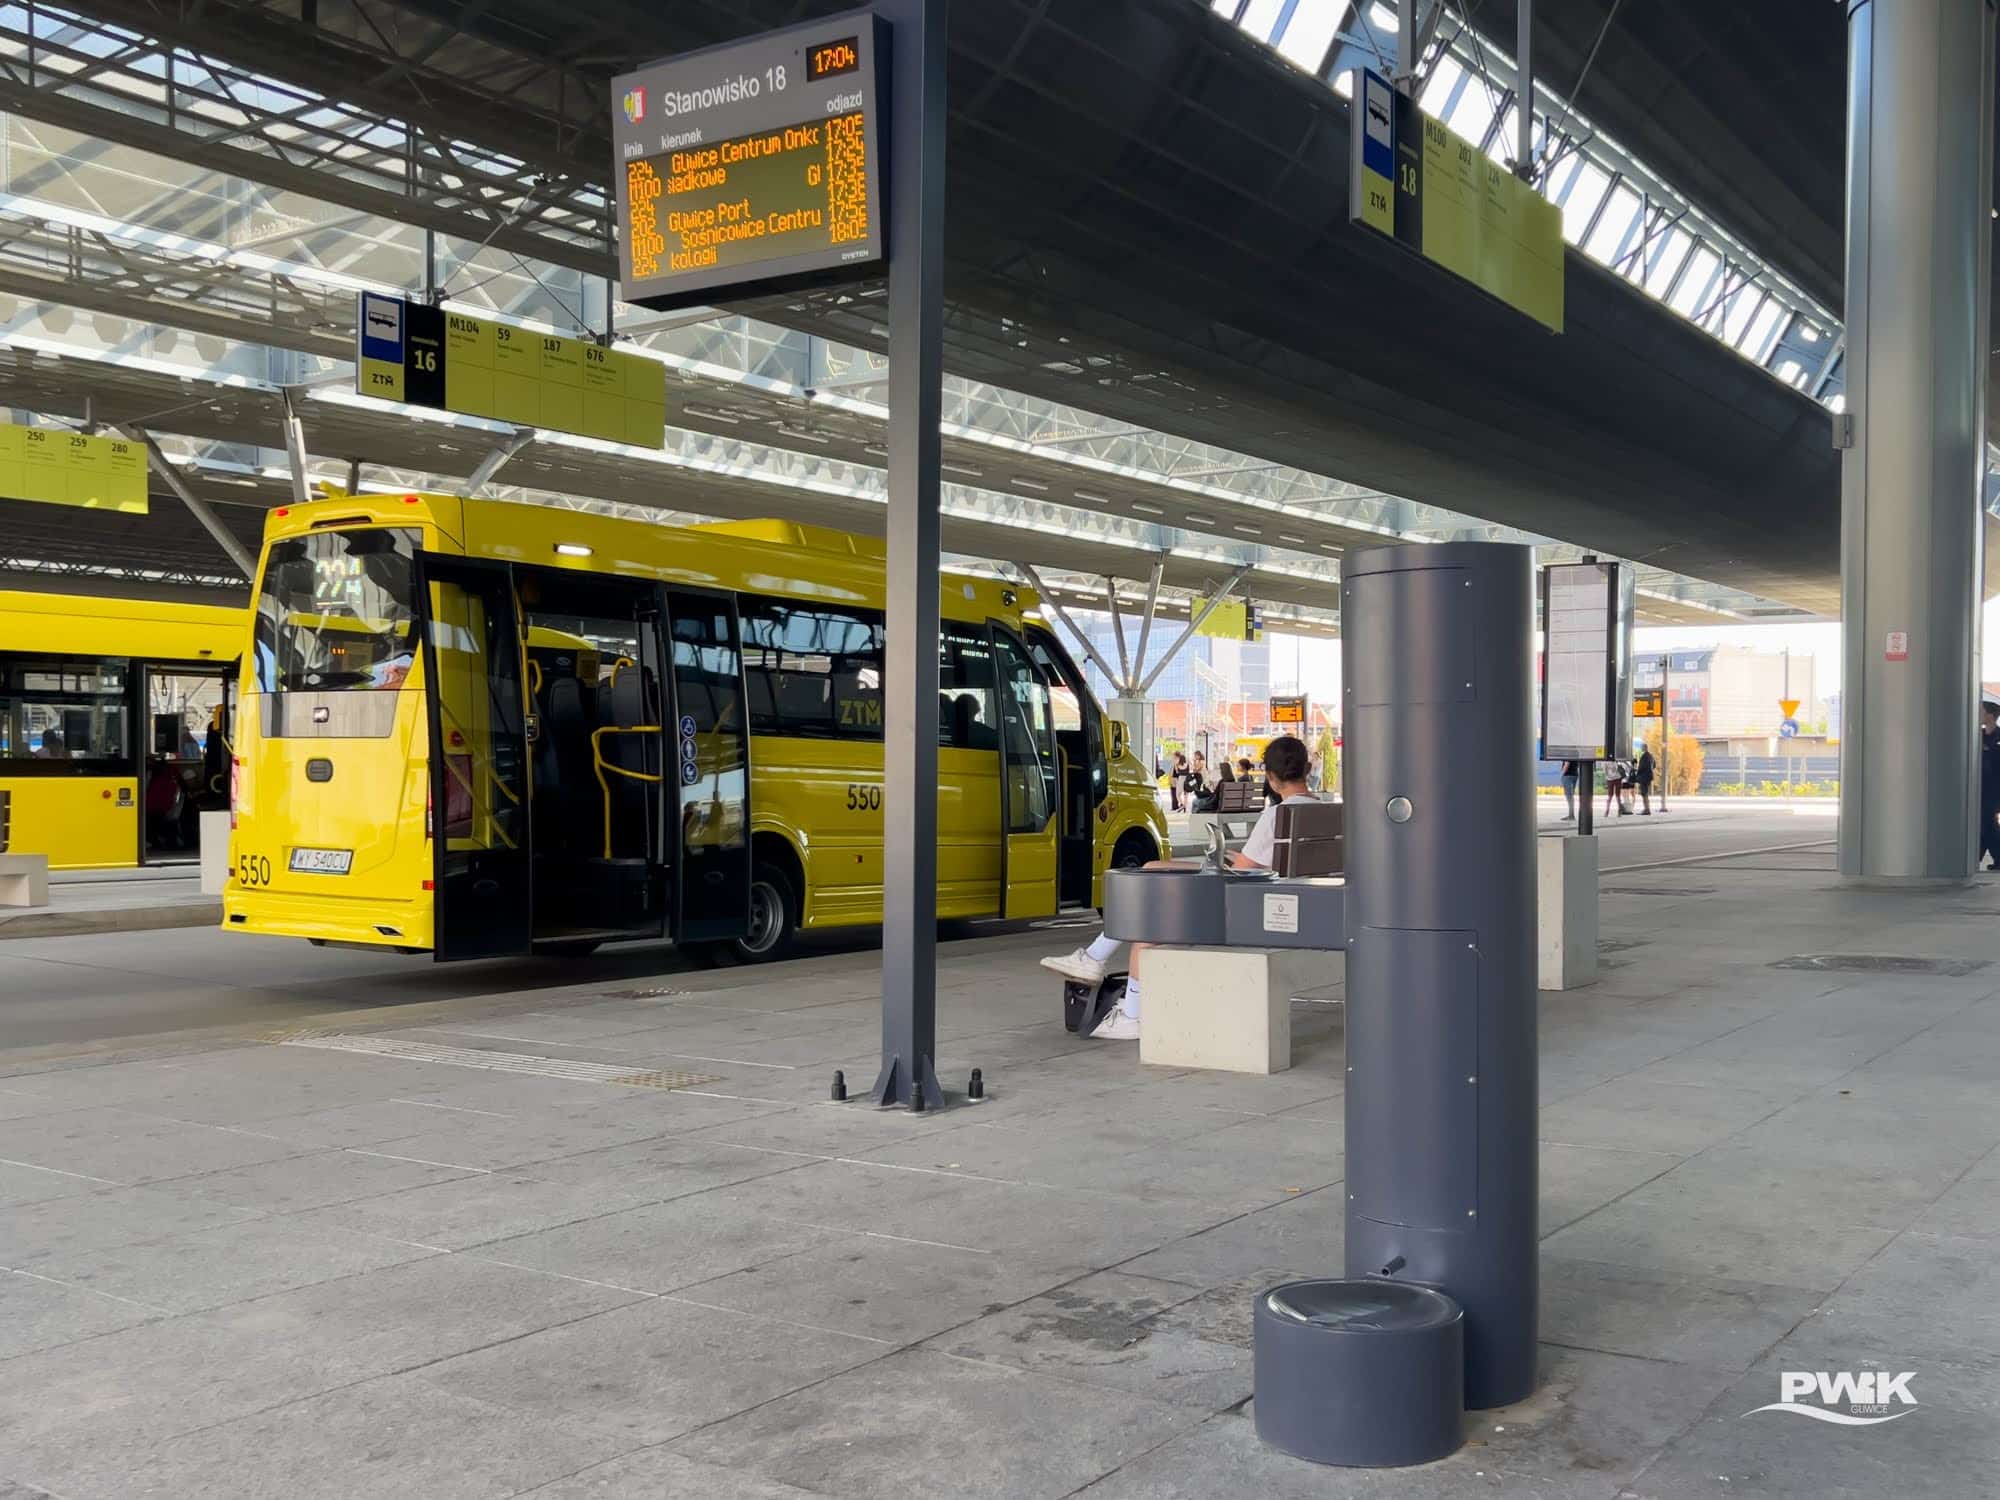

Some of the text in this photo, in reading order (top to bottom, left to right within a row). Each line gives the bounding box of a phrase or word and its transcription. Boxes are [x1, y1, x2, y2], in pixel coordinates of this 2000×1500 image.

[815, 45, 855, 73] 17:04
[664, 65, 787, 117] Stanowisko 18
[624, 90, 863, 158] linia kierunek odjazd
[672, 149, 718, 173] Gliwice
[721, 134, 781, 163] Centrum
[1401, 163, 1416, 196] 18
[669, 209, 715, 232] Gliwice
[718, 198, 751, 222] Port
[681, 219, 765, 249] Sośnicowice
[769, 208, 822, 233] Centru
[450, 317, 479, 335] M104
[498, 328, 511, 341] 59
[543, 339, 561, 353] 187
[586, 348, 604, 362] 676
[414, 350, 436, 372] 16
[27, 431, 45, 442] 250
[70, 437, 87, 448] 259
[112, 443, 128, 454] 280
[840, 699, 881, 726] ZTM
[847, 784, 881, 811] 550
[240, 854, 271, 886] 550
